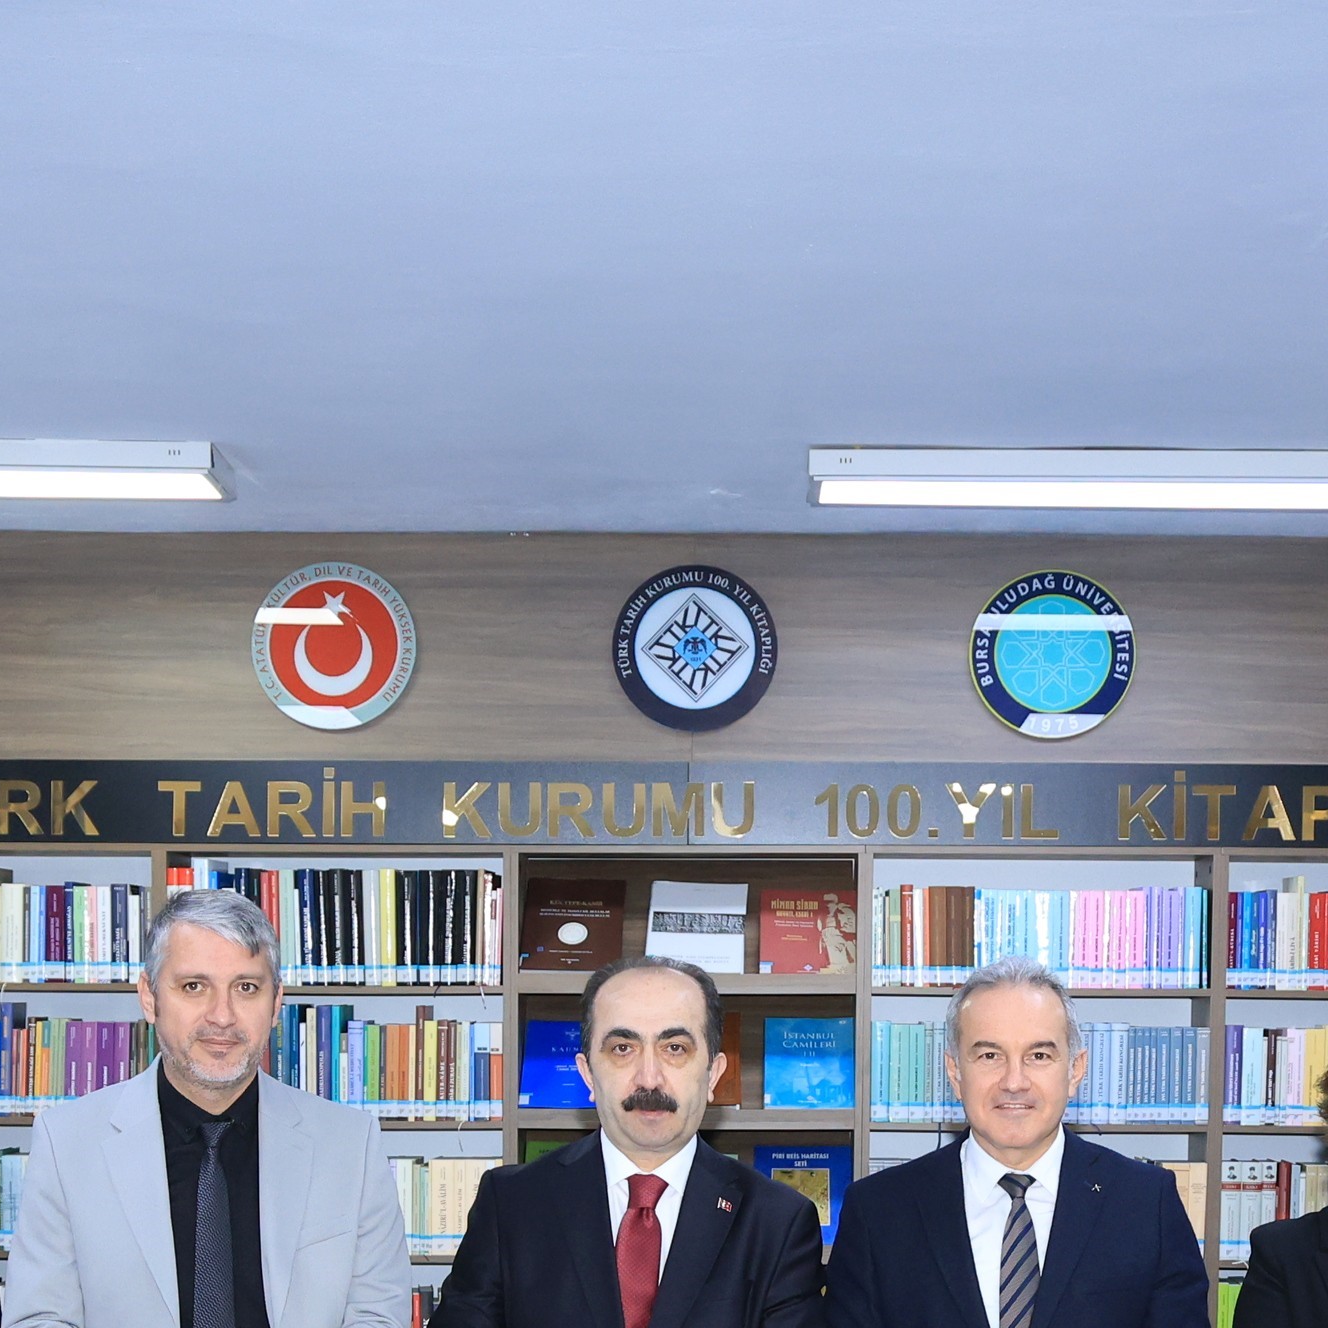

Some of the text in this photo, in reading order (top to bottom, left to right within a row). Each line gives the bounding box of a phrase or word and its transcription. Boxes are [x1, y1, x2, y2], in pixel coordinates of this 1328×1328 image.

[337, 566, 352, 576] VE
[389, 596, 413, 643] YÜKSEK
[987, 573, 1056, 619] ULUDAĞ
[617, 571, 773, 678] TÜRK TARİH KURUMU 100. YIL KİTAPLIĞI
[383, 647, 412, 702] KURUMU
[1028, 715, 1079, 732] 1975
[158, 767, 385, 838] TARİH
[443, 782, 755, 839] KURUMU
